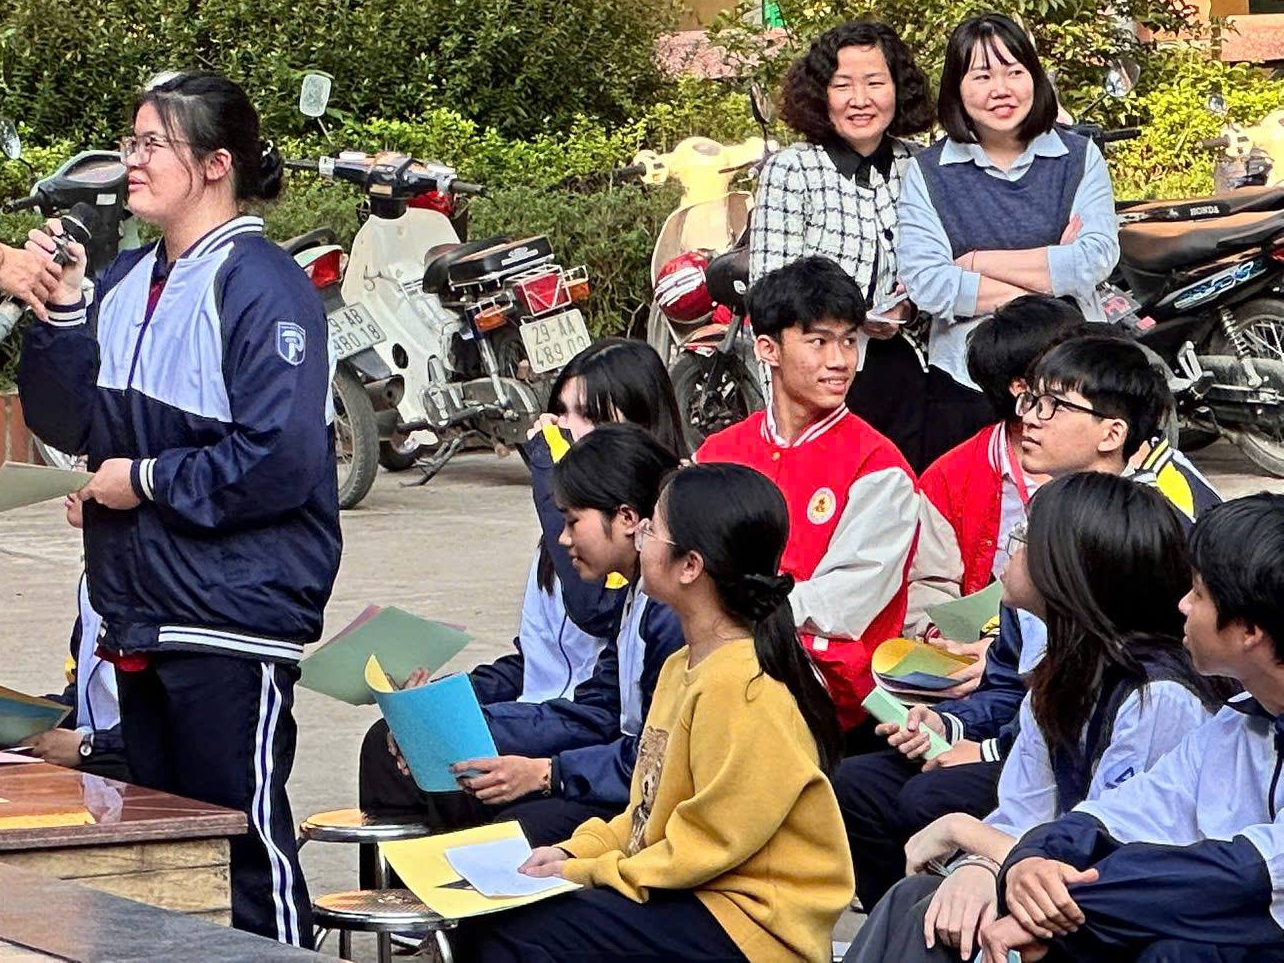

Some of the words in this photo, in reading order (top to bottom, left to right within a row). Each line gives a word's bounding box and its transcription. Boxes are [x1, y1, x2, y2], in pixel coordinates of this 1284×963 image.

[1189, 205, 1220, 216] HONDA
[327, 308, 363, 335] 9-AB
[531, 315, 576, 345] 29-AA
